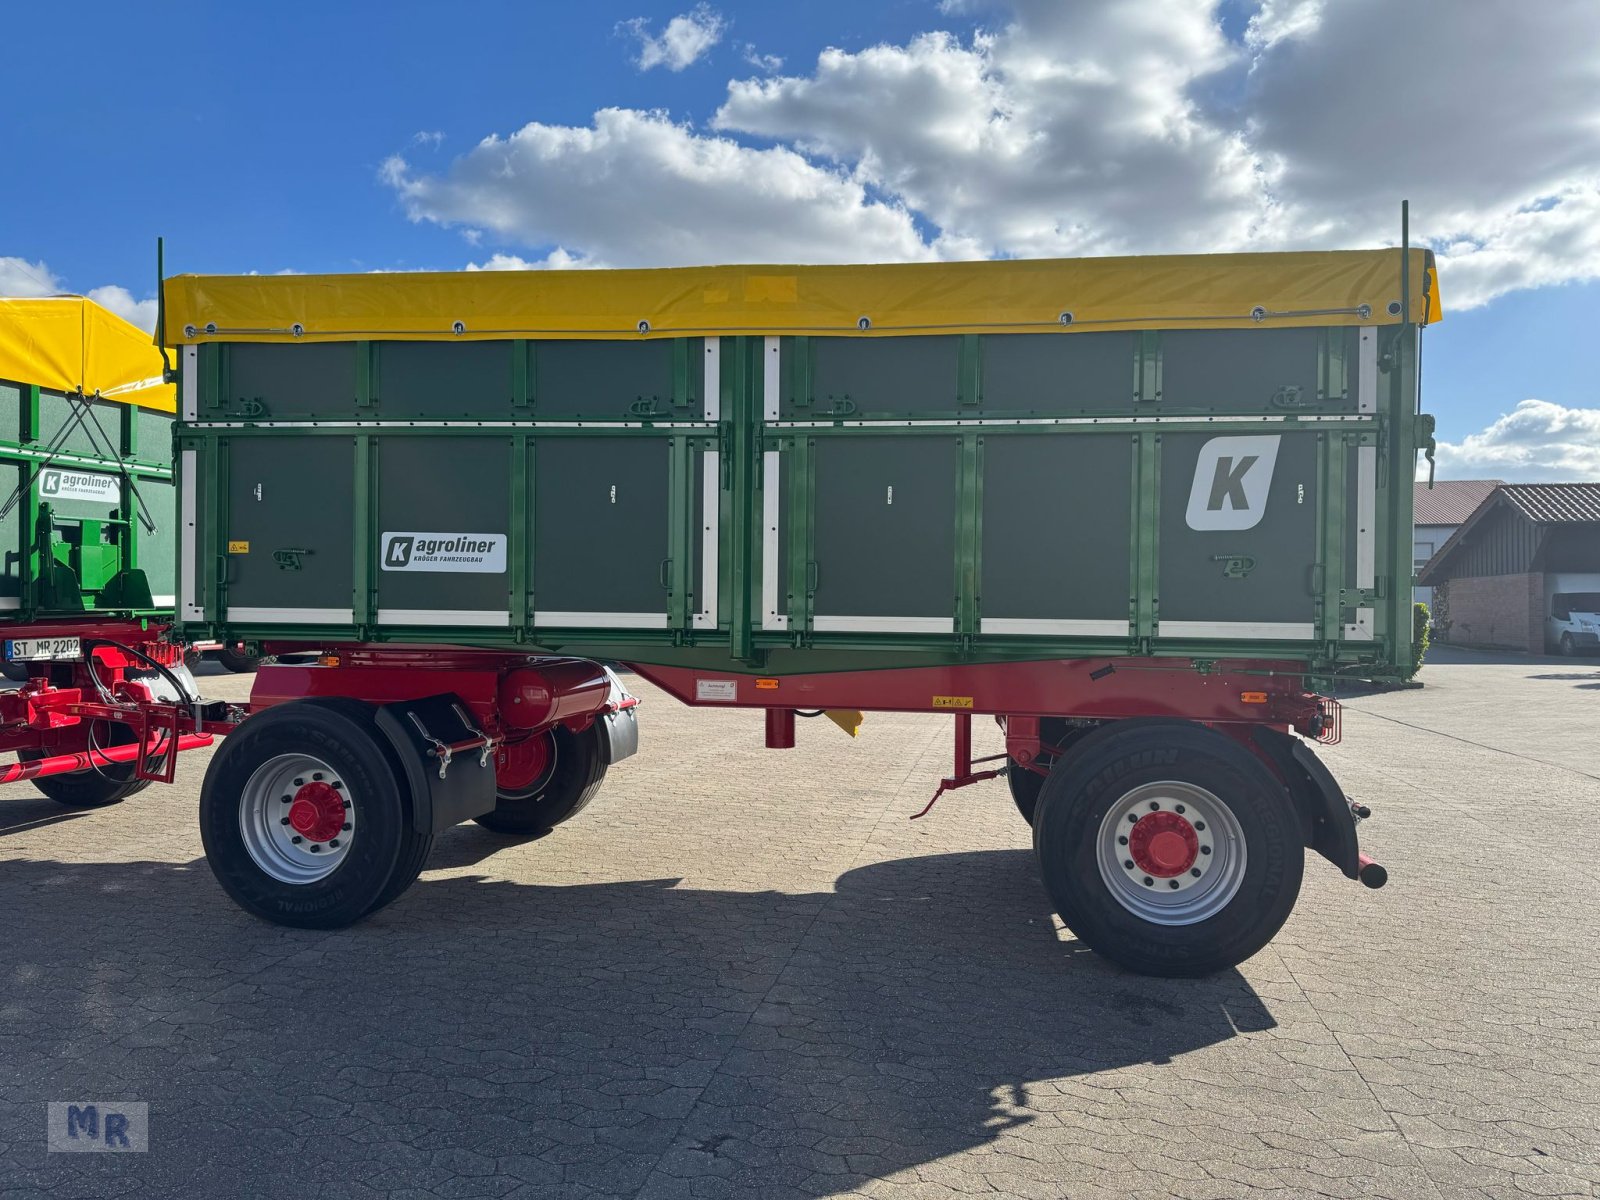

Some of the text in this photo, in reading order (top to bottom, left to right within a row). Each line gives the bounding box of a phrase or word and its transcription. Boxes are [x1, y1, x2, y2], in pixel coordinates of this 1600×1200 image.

[63, 475, 113, 489] agroliner
[1207, 455, 1260, 511] K
[415, 536, 497, 556] agroliner
[13, 639, 79, 656] ST MR 2202
